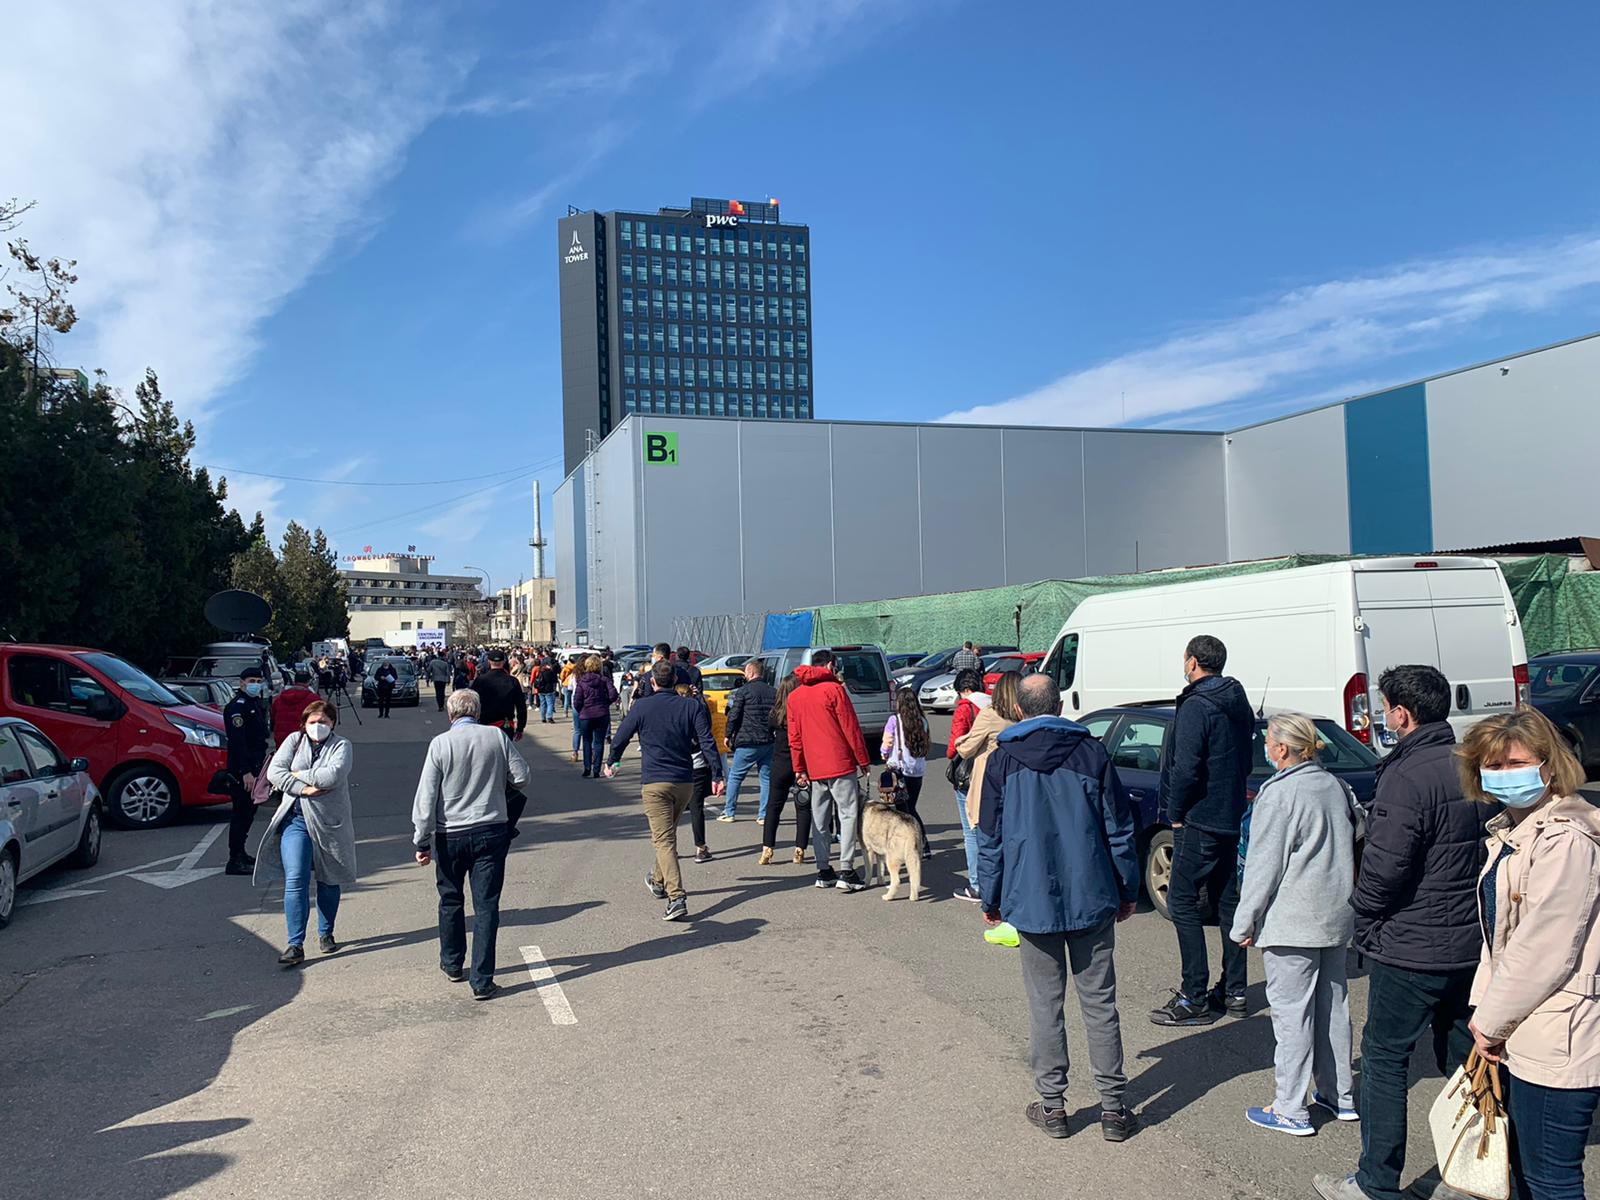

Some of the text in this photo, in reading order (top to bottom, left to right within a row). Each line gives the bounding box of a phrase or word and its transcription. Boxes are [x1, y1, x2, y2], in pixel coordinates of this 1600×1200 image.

[705, 214, 738, 228] pwc
[568, 245, 584, 255] ANA
[564, 252, 589, 264] TOWER
